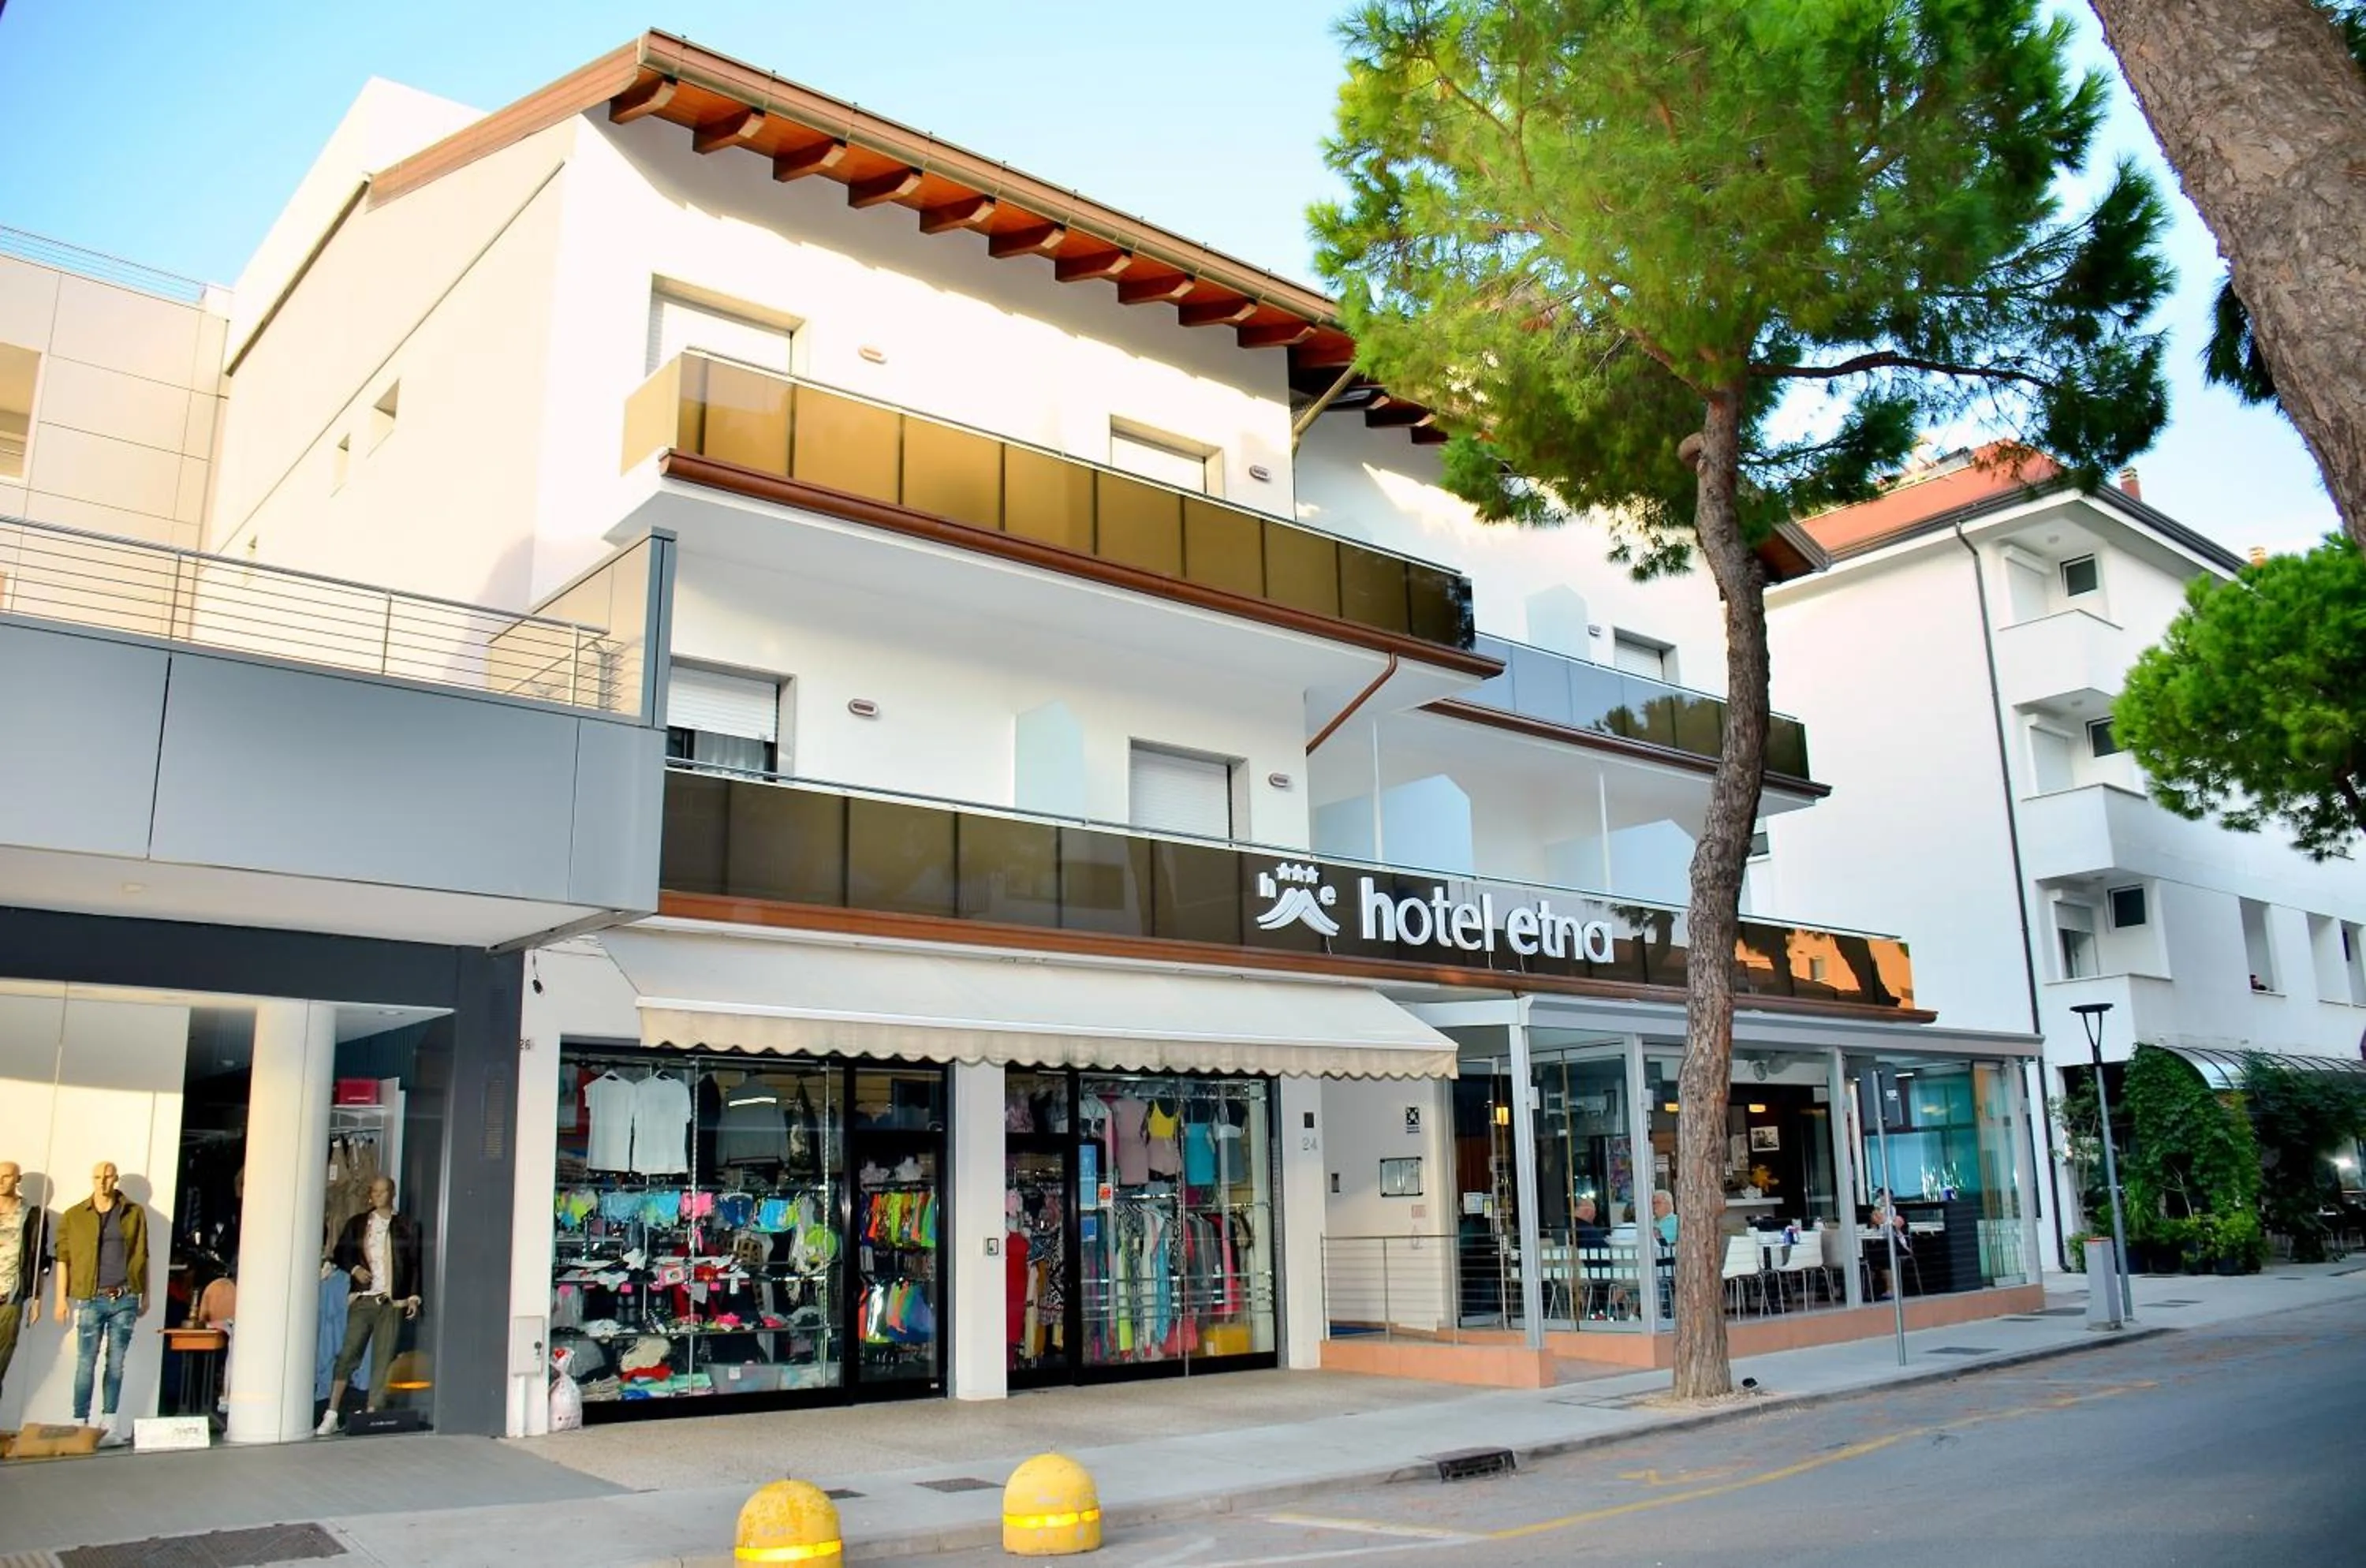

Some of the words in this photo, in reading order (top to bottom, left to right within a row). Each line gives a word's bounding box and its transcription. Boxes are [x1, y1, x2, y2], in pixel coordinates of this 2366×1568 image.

[1358, 876, 1495, 952] hotel
[1506, 899, 1615, 964] etna
[1301, 1137, 1318, 1151] 24
